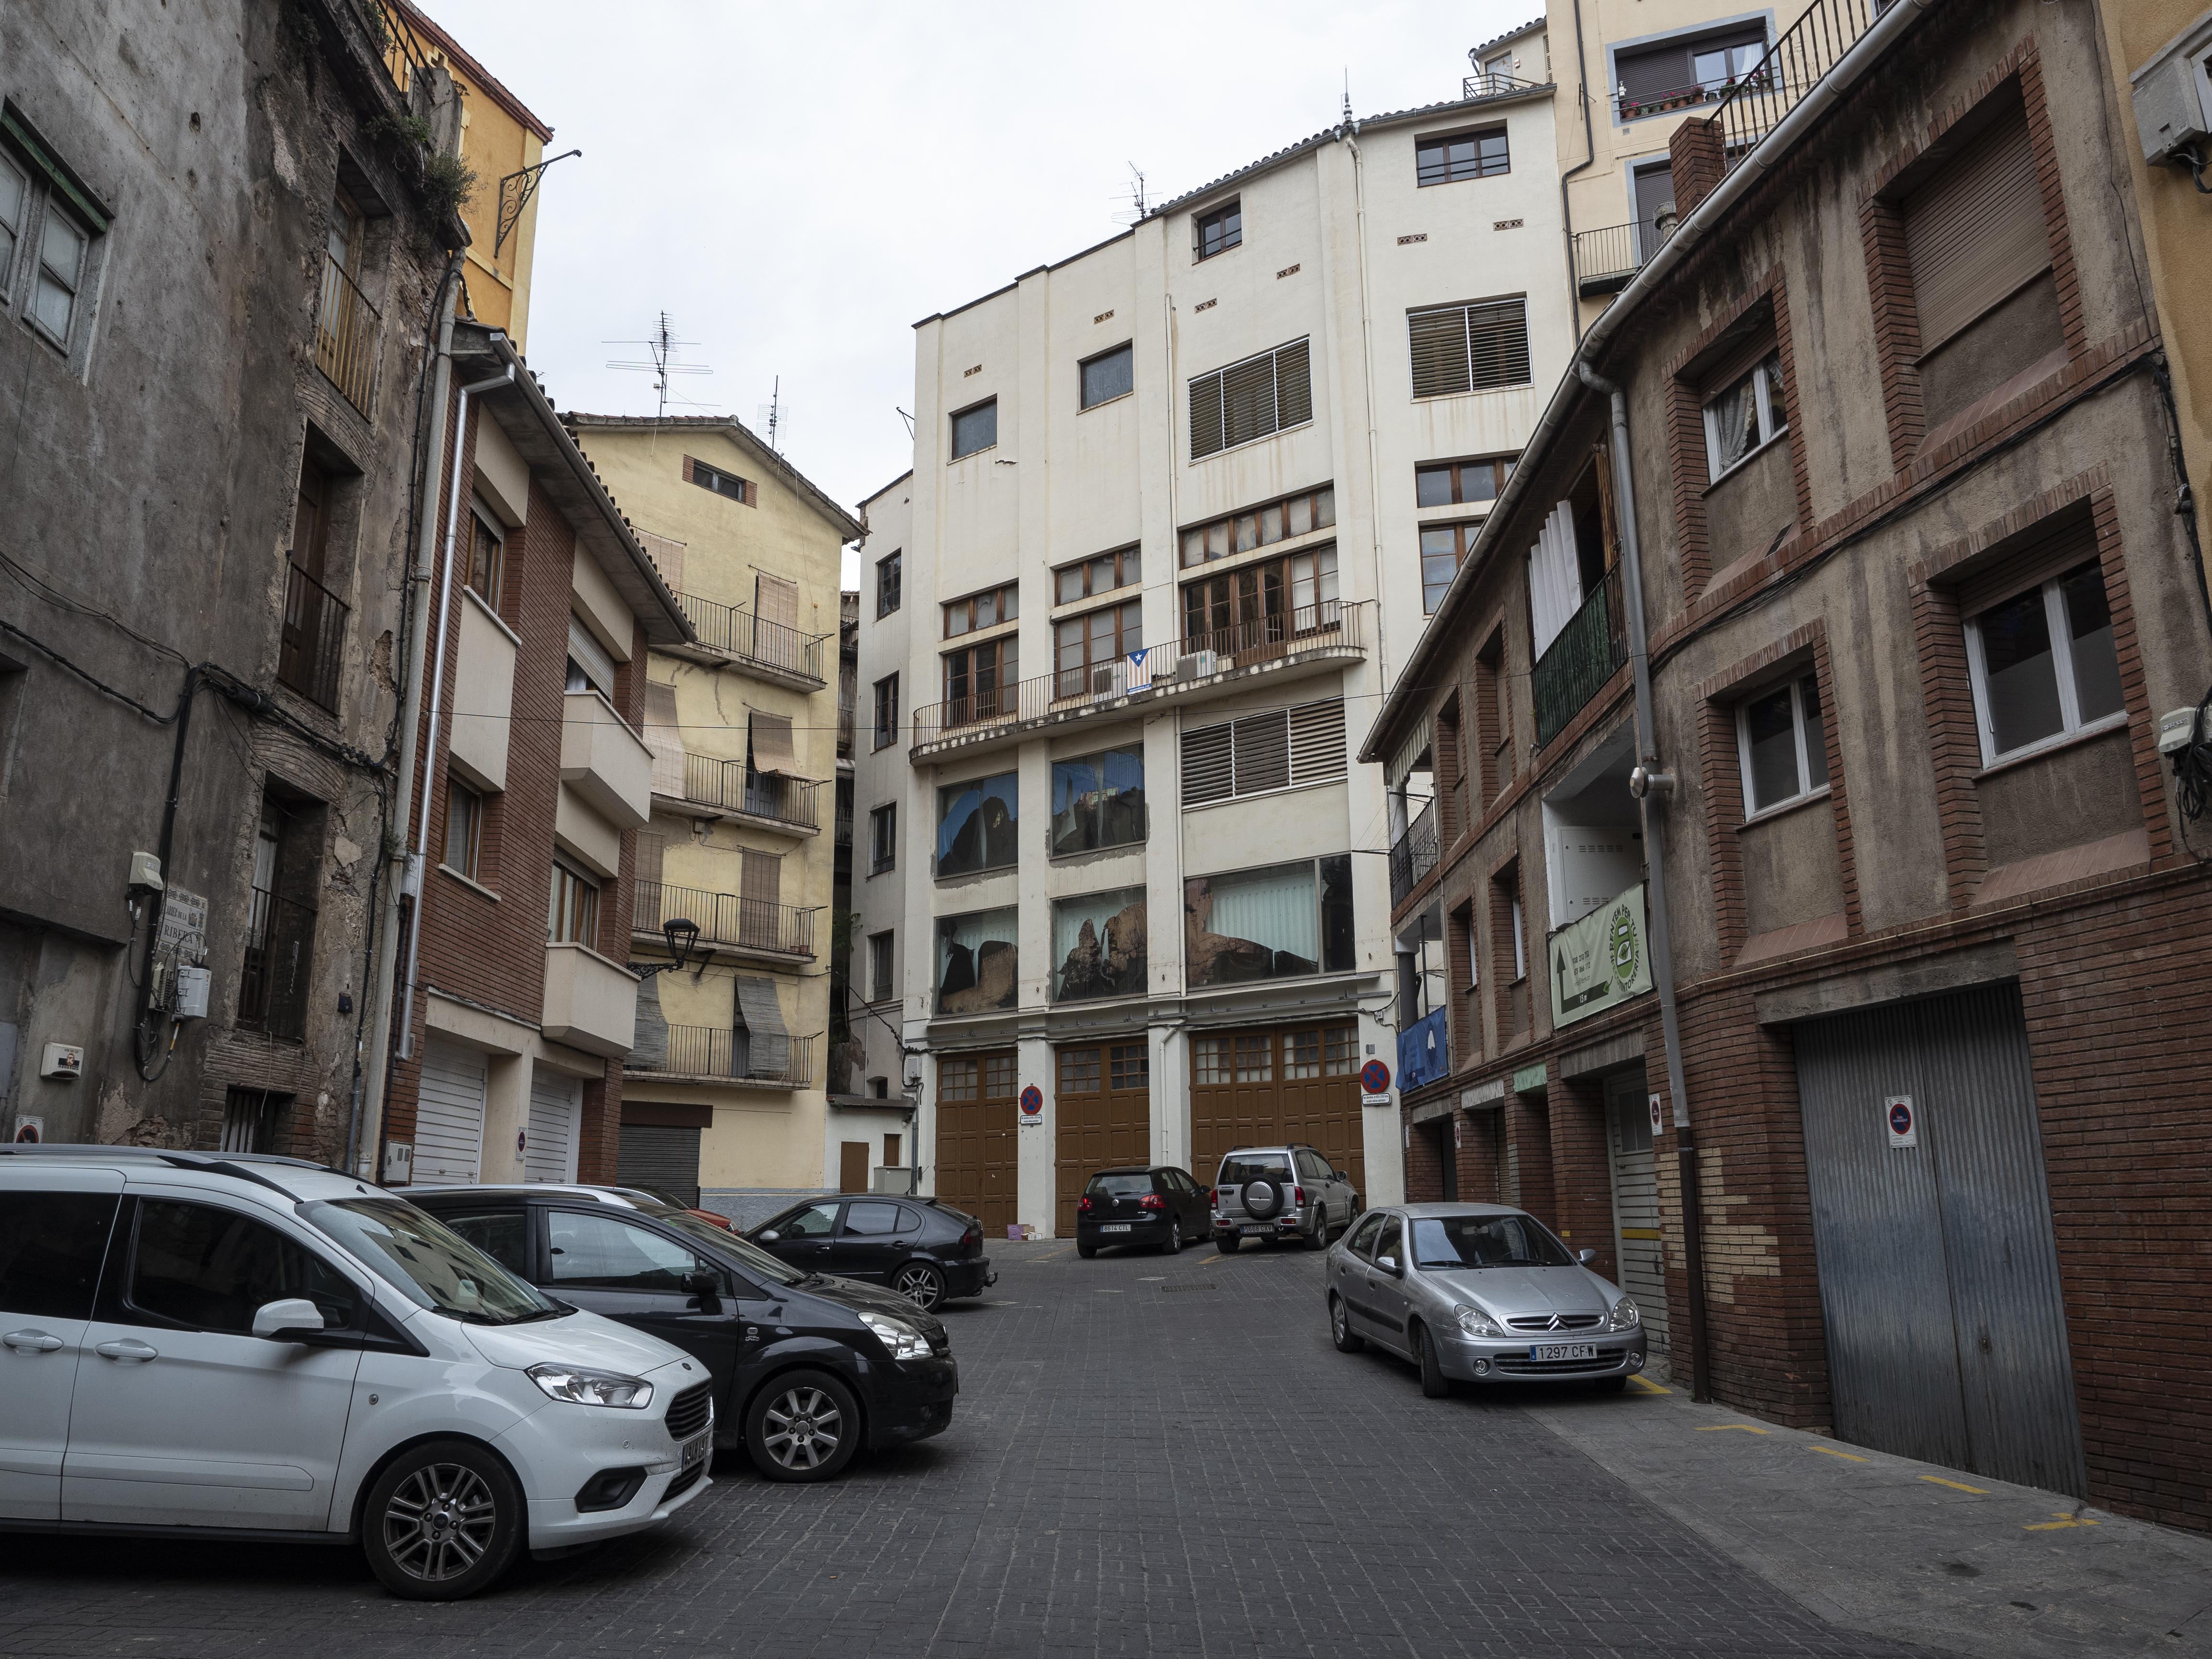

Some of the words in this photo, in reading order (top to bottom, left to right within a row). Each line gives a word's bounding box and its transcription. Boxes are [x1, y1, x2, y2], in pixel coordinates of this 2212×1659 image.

[1622, 904, 1630, 922] PER
[1631, 918, 1637, 937] TU
[164, 925, 192, 944] RIBERA
[1539, 1346, 1568, 1359] 1297
[1572, 1345, 1594, 1358] CFW
